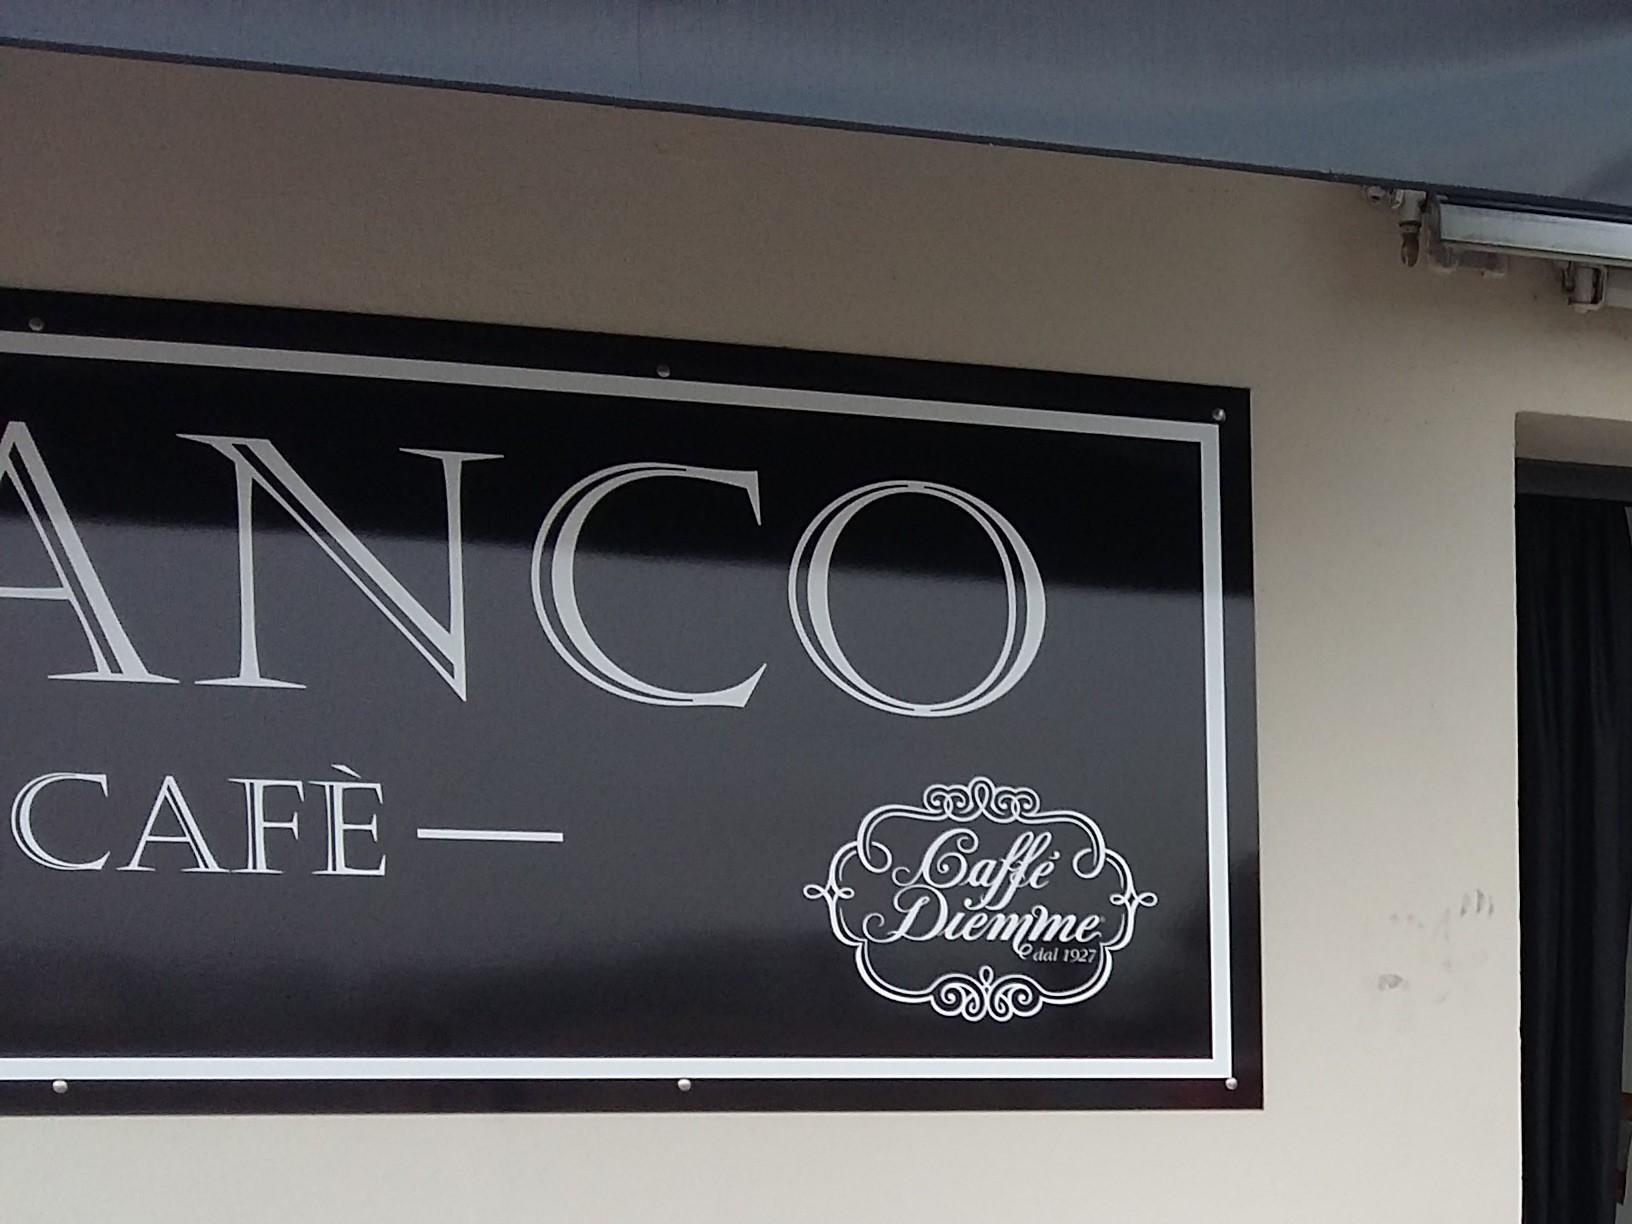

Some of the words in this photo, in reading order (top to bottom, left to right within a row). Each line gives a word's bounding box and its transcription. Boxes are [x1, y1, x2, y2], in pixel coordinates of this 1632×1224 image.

[10, 763, 387, 877] CAFÈ
[862, 883, 1103, 961] Diemme
[1031, 946, 1059, 963] dal
[1062, 948, 1097, 965] 1927
